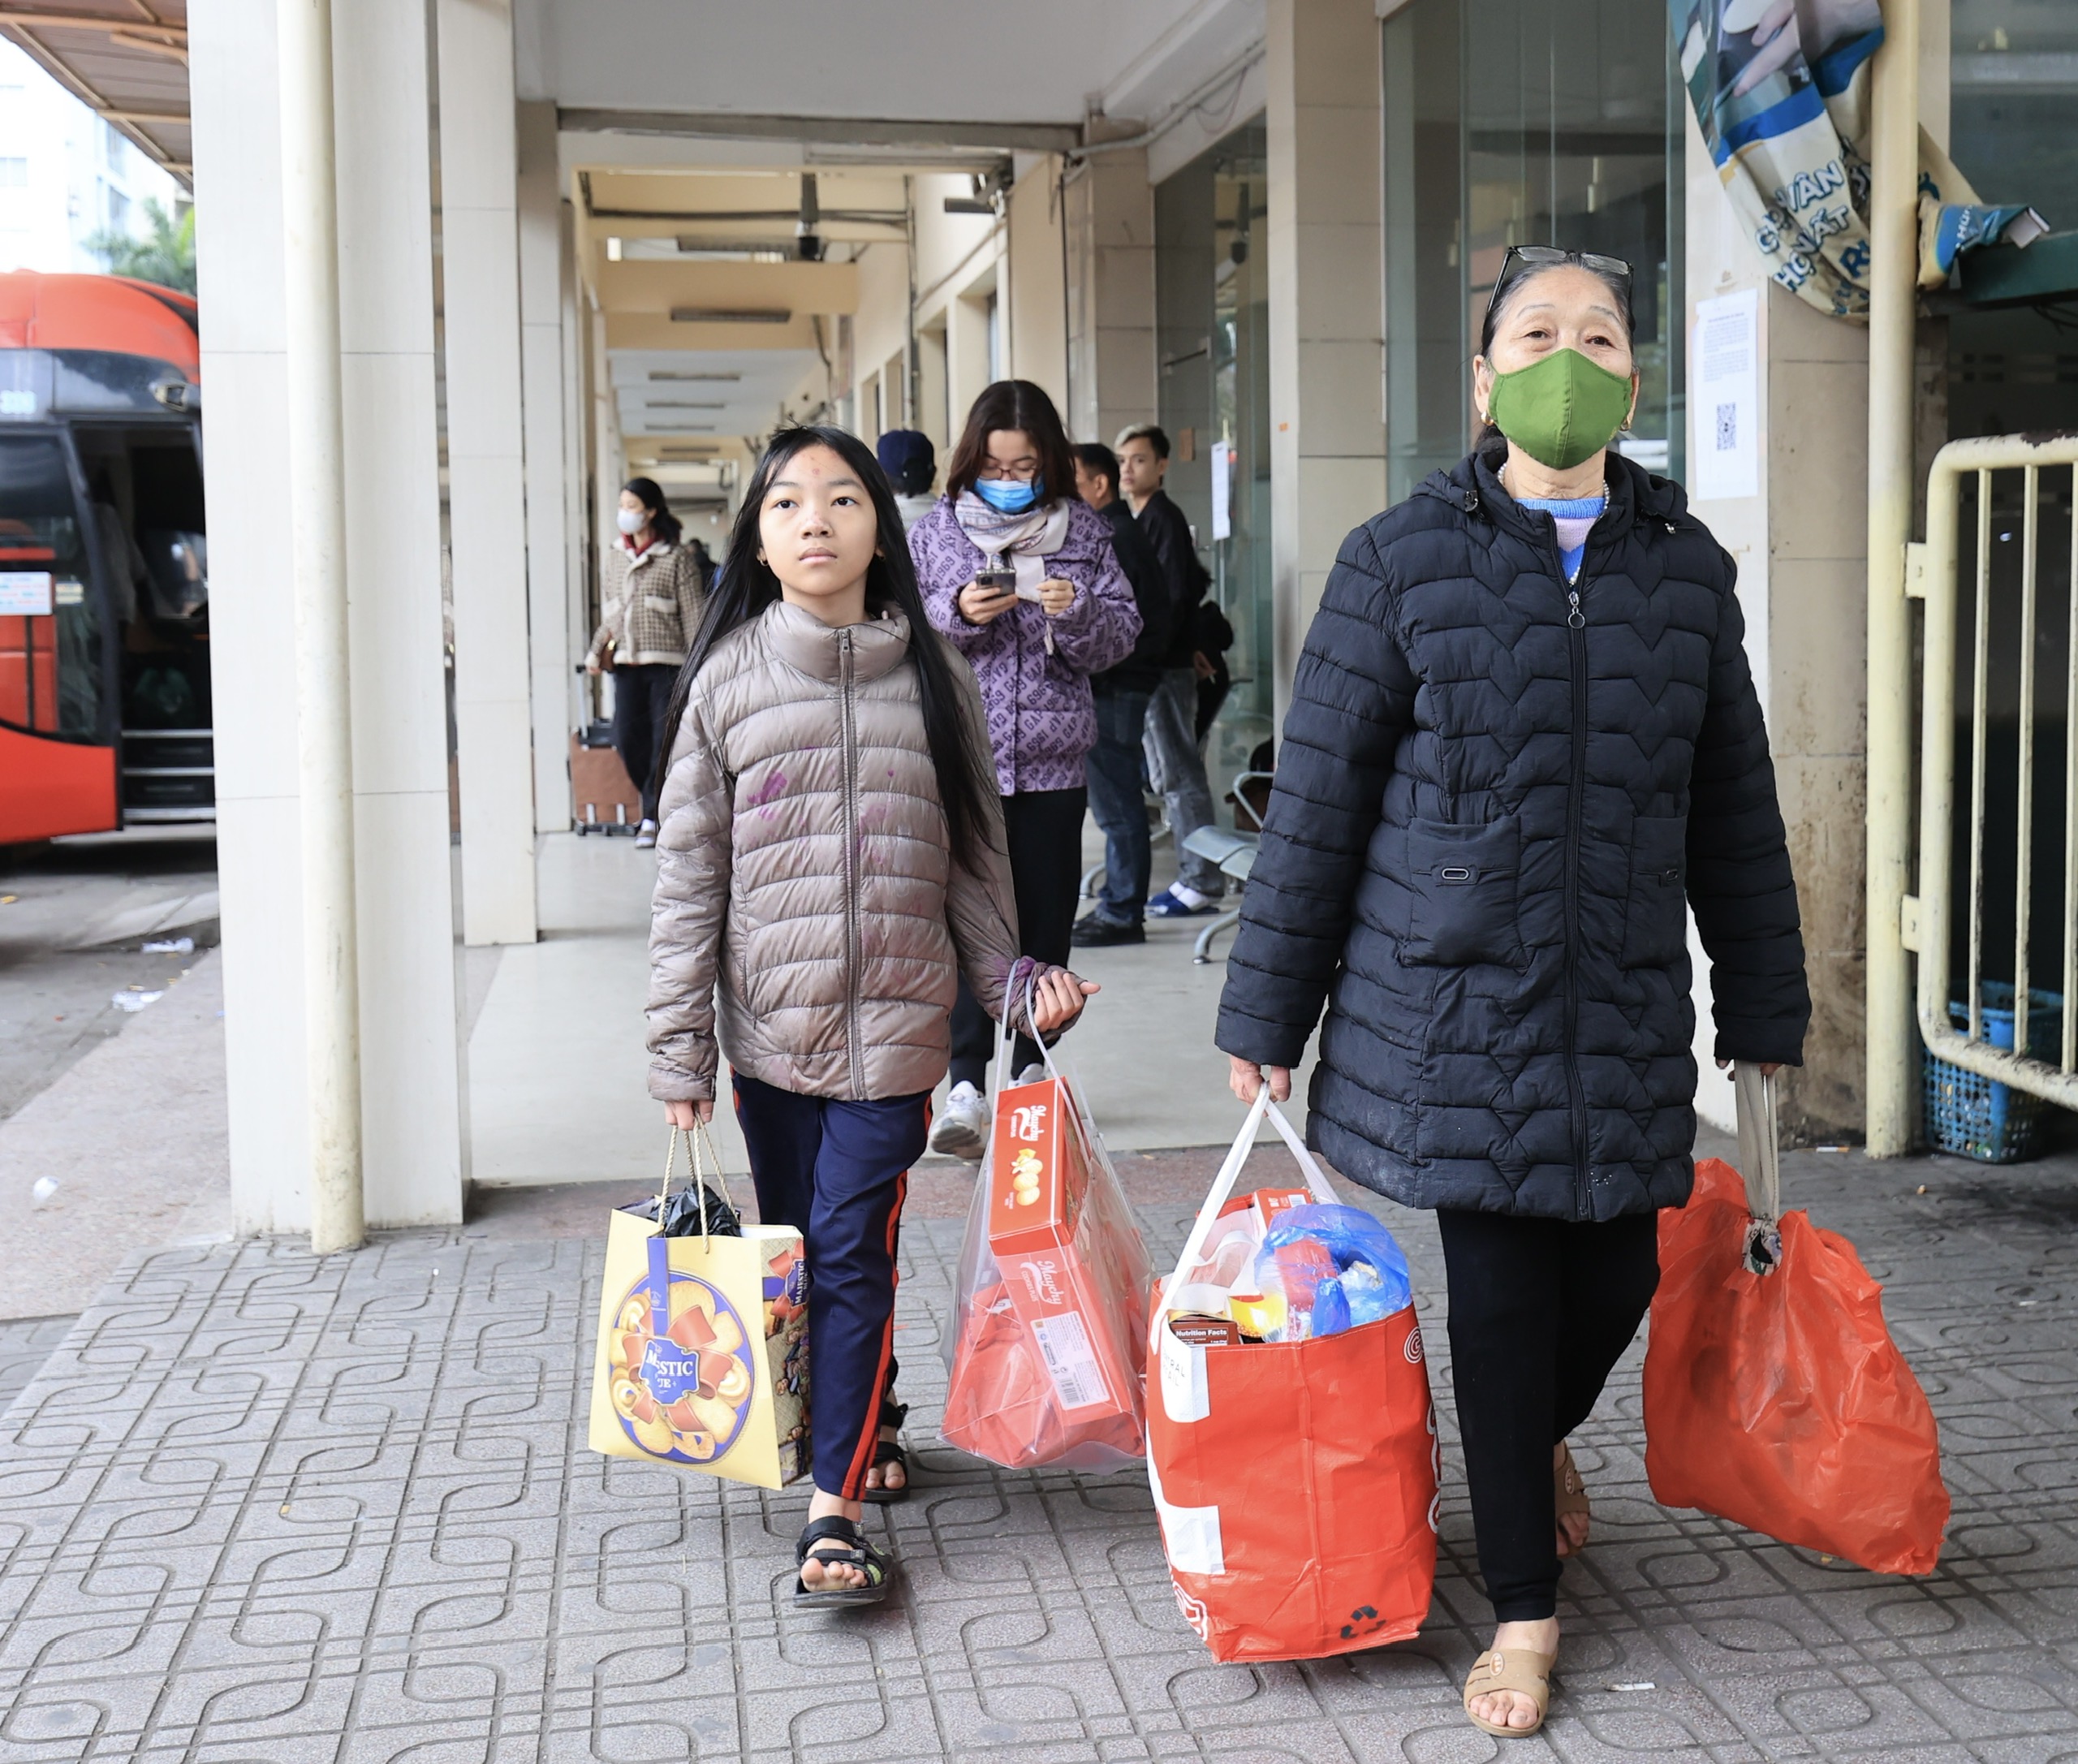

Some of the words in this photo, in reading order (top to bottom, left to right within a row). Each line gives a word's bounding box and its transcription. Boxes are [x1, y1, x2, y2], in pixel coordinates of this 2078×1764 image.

[935, 555, 956, 581] 1969
[1024, 709, 1044, 731] GAP
[1026, 729, 1050, 752] 1969
[1034, 1260, 1064, 1305] Maychy
[1175, 1329, 1207, 1337] Nutrition
